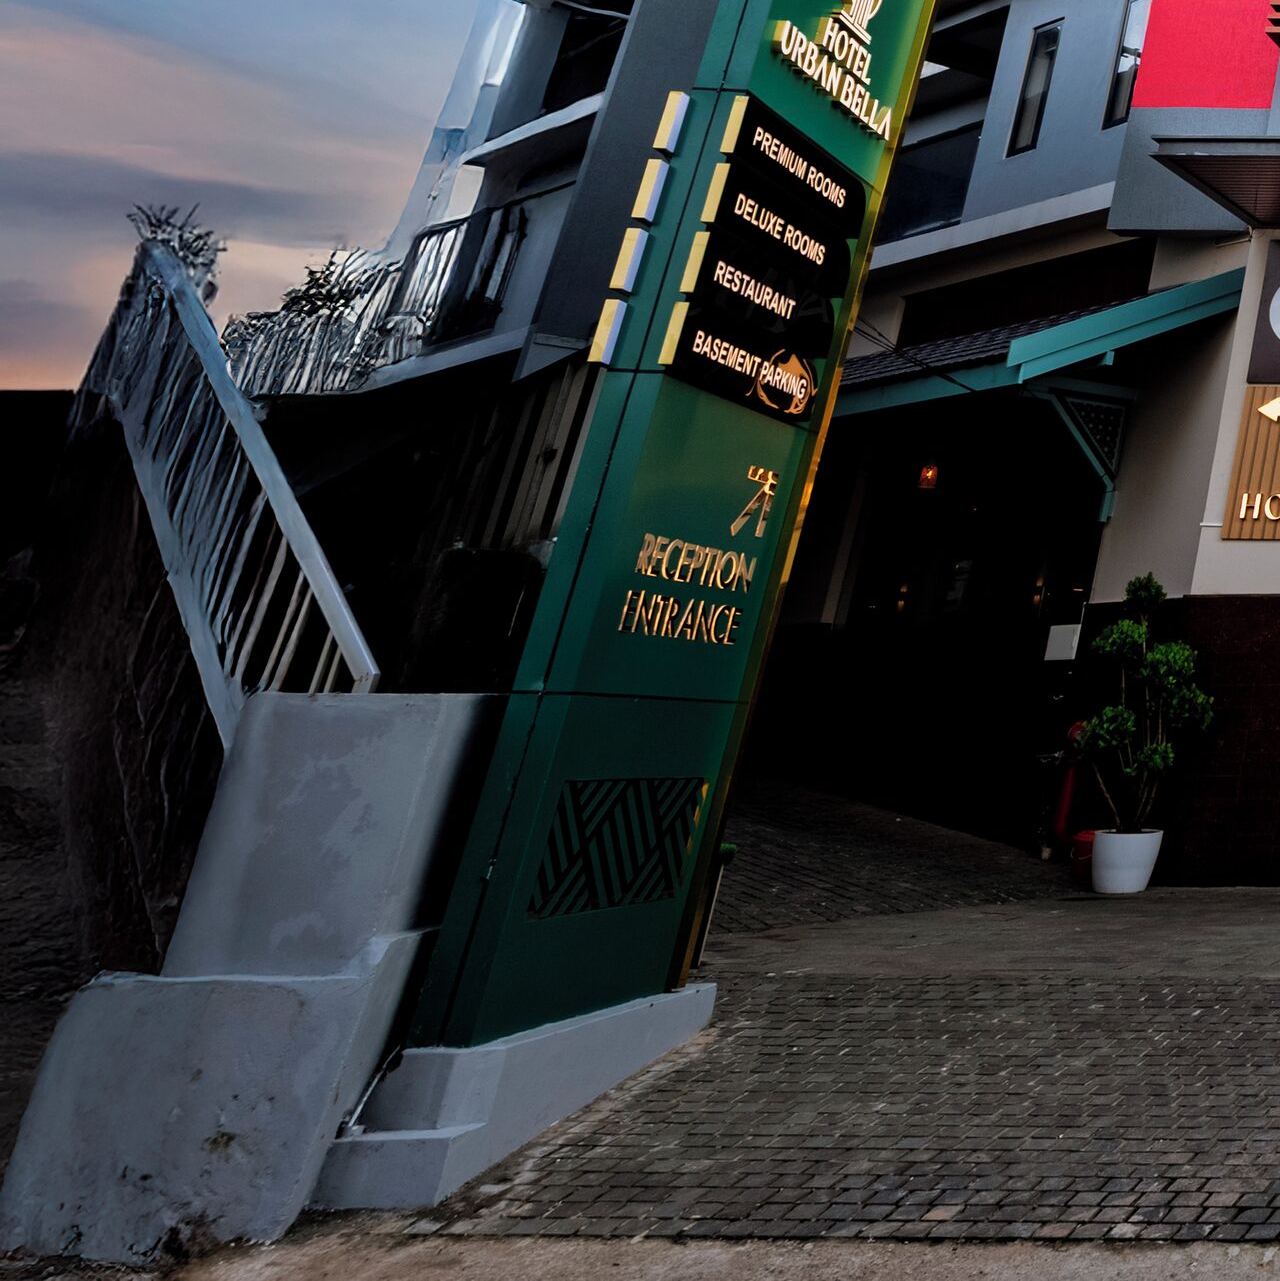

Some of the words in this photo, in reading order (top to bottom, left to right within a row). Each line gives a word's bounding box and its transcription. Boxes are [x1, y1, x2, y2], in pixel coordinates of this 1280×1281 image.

[780, 20, 843, 97] URBAN
[839, 73, 892, 141] BELLA
[820, 17, 872, 86] HOTEL
[752, 126, 808, 181] PREMIUM
[806, 165, 847, 208] ROOMS
[734, 192, 785, 240] DELUXE
[783, 224, 826, 266] ROOMS
[713, 260, 797, 320] RESTAURANT
[692, 330, 762, 378] BASEMENT
[759, 360, 808, 399] PARKING
[634, 532, 758, 594] RECEPTION
[617, 589, 744, 645] ENTRANCE
